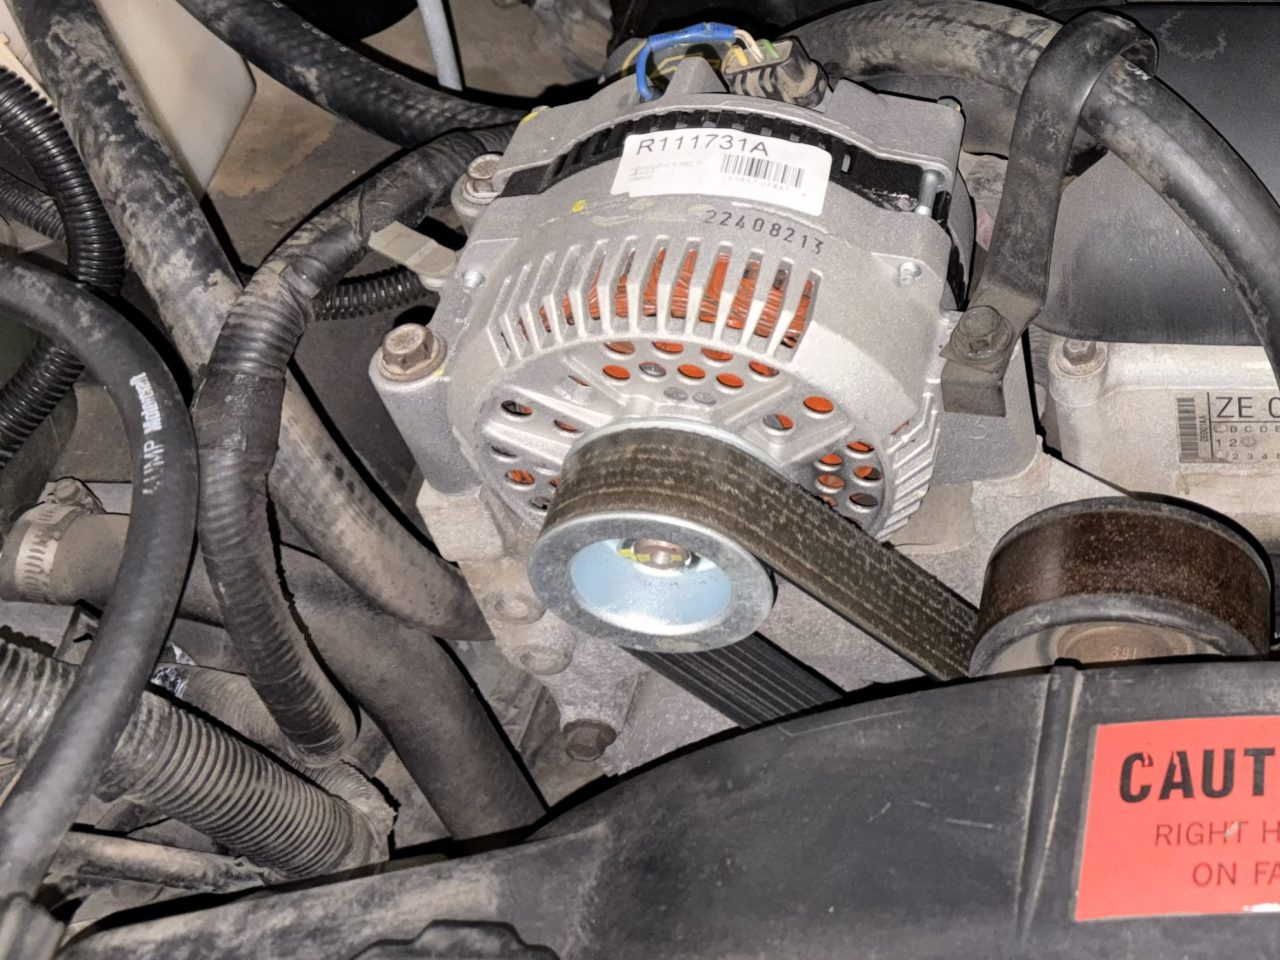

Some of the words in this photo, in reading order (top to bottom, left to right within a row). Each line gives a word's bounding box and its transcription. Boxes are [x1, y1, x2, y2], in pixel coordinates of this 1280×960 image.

[636, 133, 769, 157] R111731A
[704, 209, 824, 255] 22408213
[1215, 396, 1255, 419] ZE
[1154, 820, 1247, 848] RIGHT
[1192, 861, 1237, 889] ON
